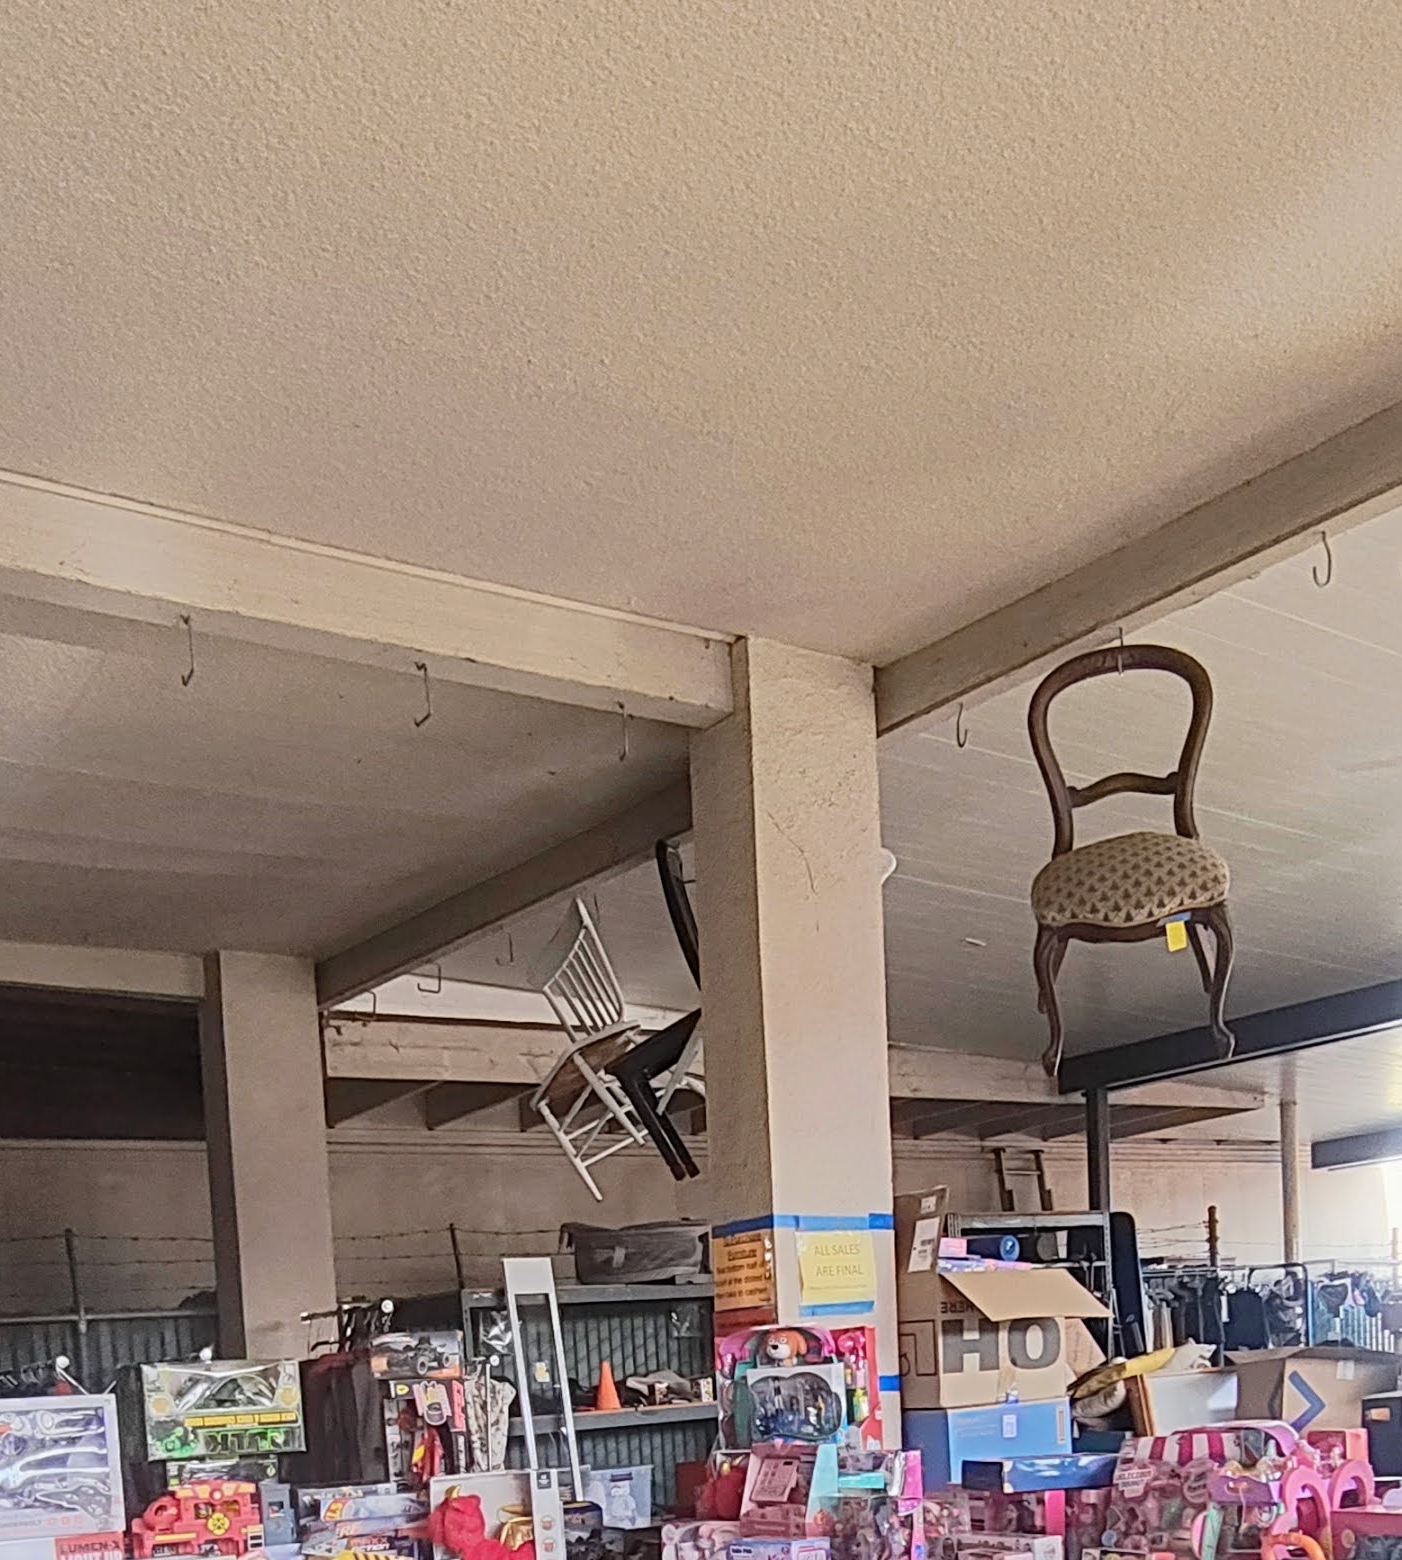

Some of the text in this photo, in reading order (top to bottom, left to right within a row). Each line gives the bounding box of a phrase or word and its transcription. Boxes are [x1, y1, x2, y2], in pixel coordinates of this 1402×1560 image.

[814, 1243, 861, 1257] ALL SALES
[815, 1266, 864, 1278] ARE FINAL
